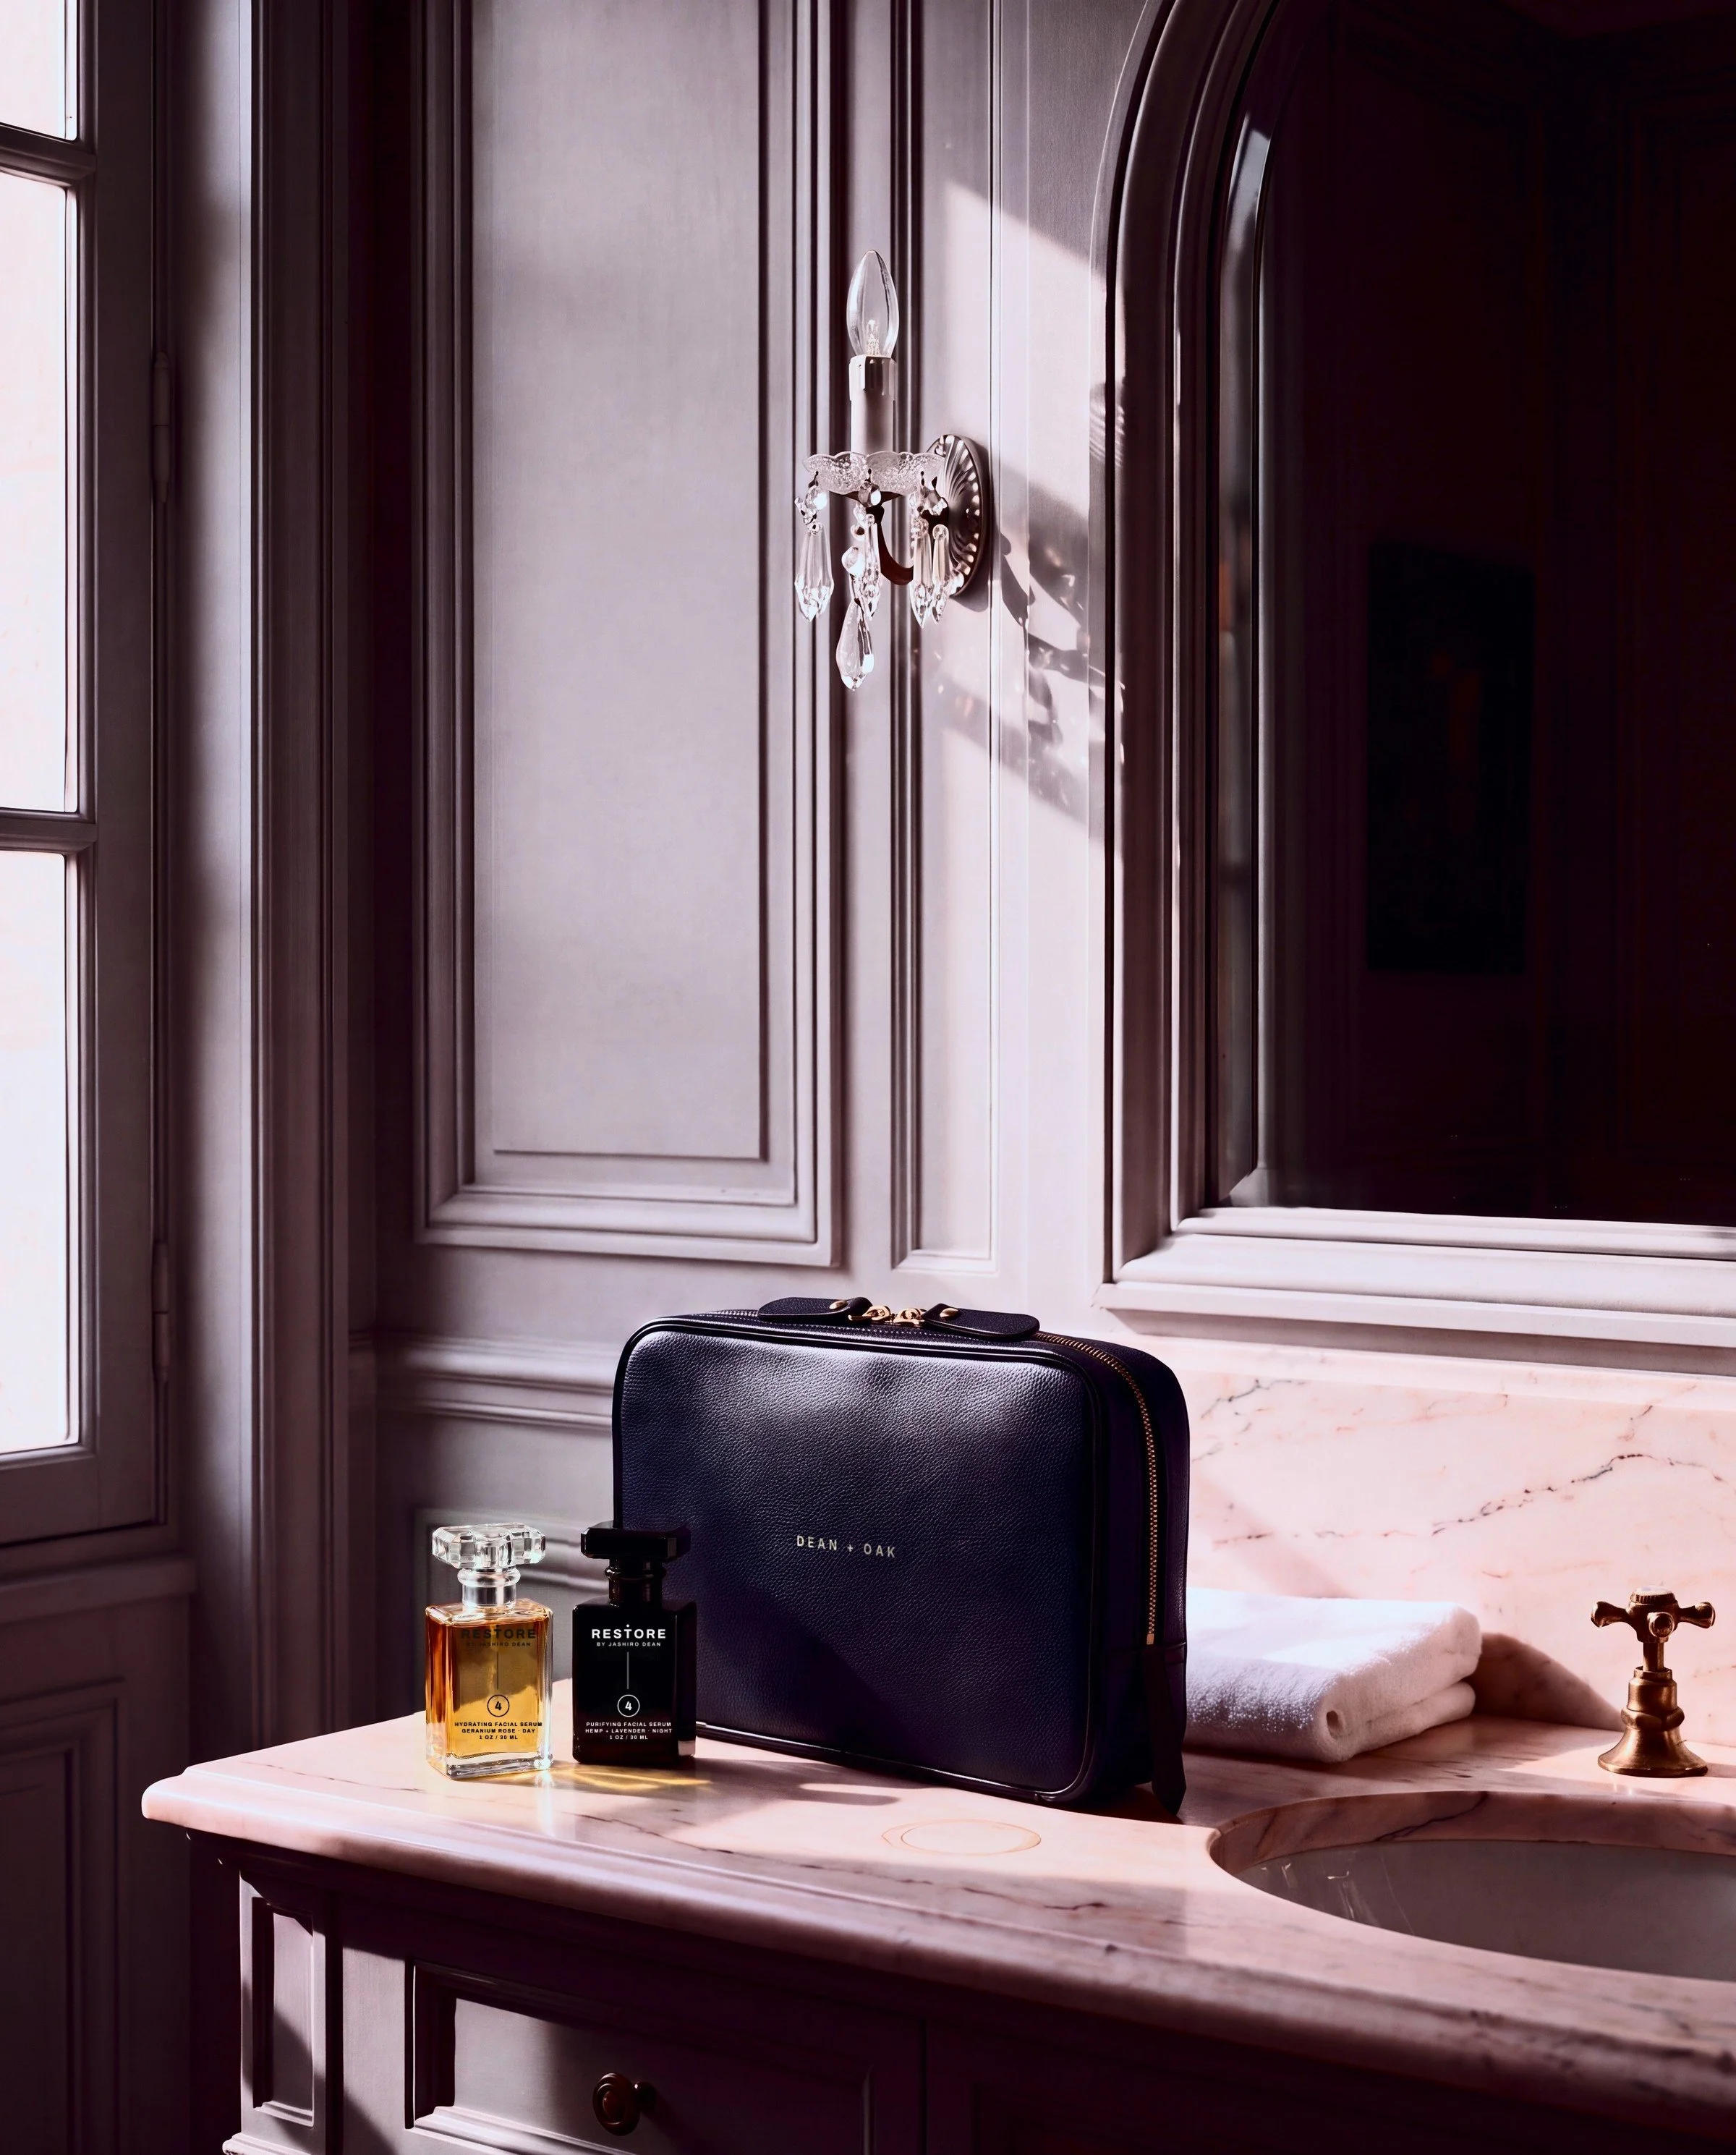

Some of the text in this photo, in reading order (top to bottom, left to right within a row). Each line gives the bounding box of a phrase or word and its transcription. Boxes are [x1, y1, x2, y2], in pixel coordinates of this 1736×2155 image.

[796, 1534, 895, 1558] DEAN + OAK
[461, 1628, 536, 1639] RESTORE
[591, 1628, 666, 1639] RESTORE
[494, 1701, 502, 1711] 4
[624, 1701, 632, 1711] 4
